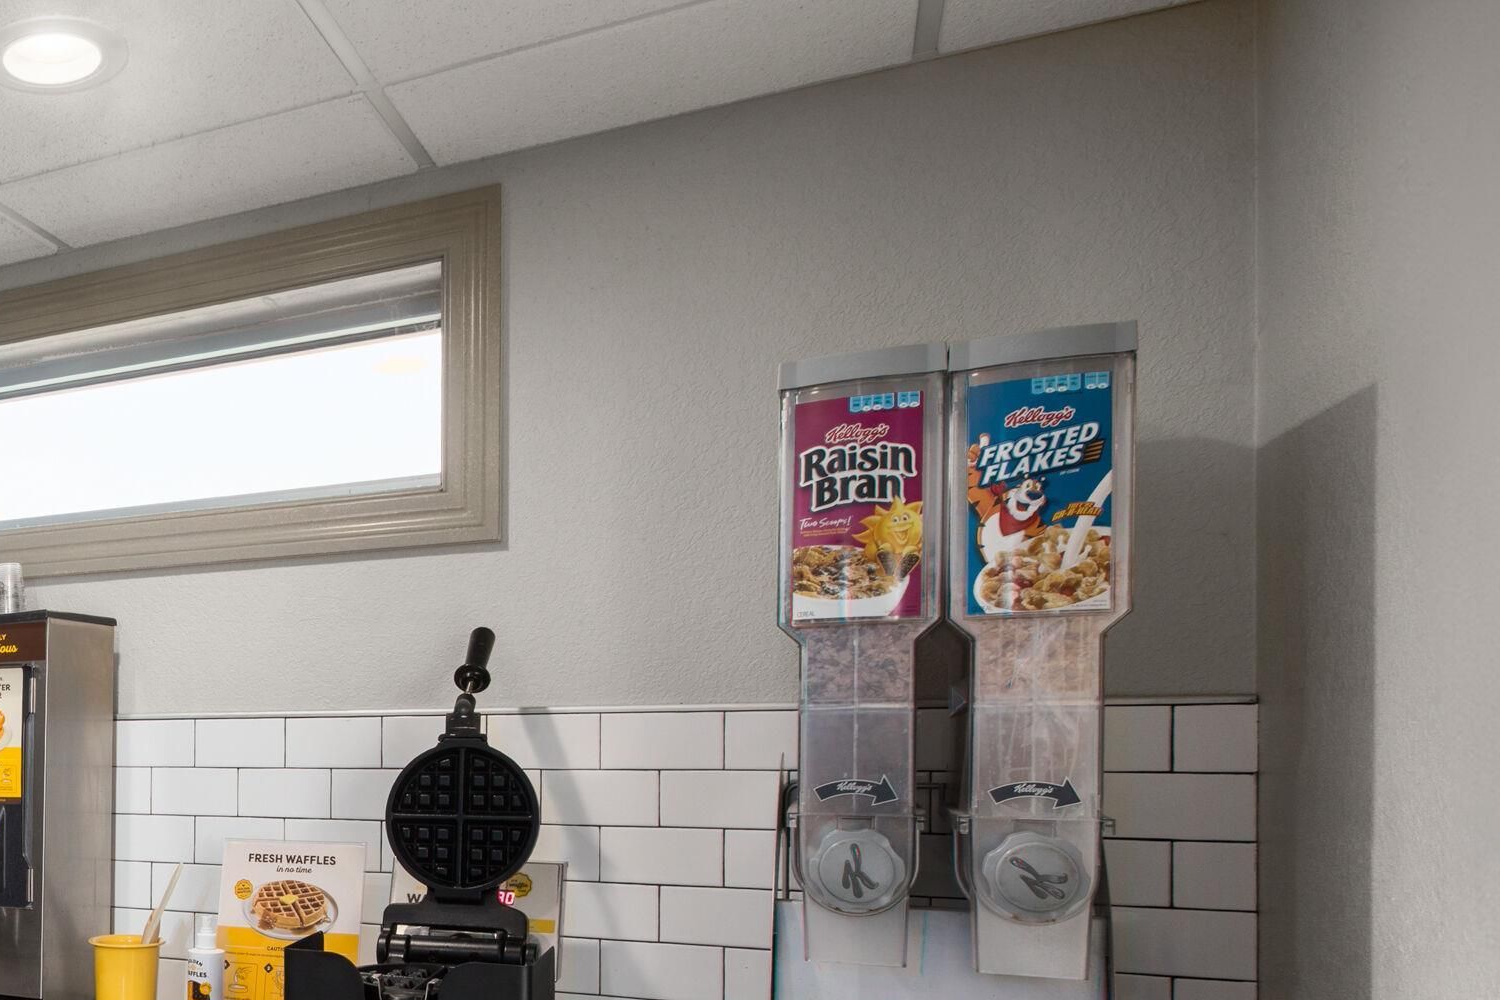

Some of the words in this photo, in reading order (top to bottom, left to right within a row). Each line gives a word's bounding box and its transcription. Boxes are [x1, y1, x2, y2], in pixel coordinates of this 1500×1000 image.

[1005, 406, 1075, 428] Kellogg's
[825, 423, 890, 443] Kellogg's
[979, 422, 1099, 467] FROSTED
[801, 442, 915, 485] Raisin
[980, 444, 1084, 486] FLAKES
[814, 474, 902, 509] Bran
[800, 518, 817, 531] Two
[836, 782, 873, 793] Kellogg's
[1013, 783, 1054, 795] Kellogg's
[248, 853, 282, 864] FRESH
[286, 854, 336, 865] WAFFLES
[276, 865, 284, 873] in
[296, 866, 312, 874] time
